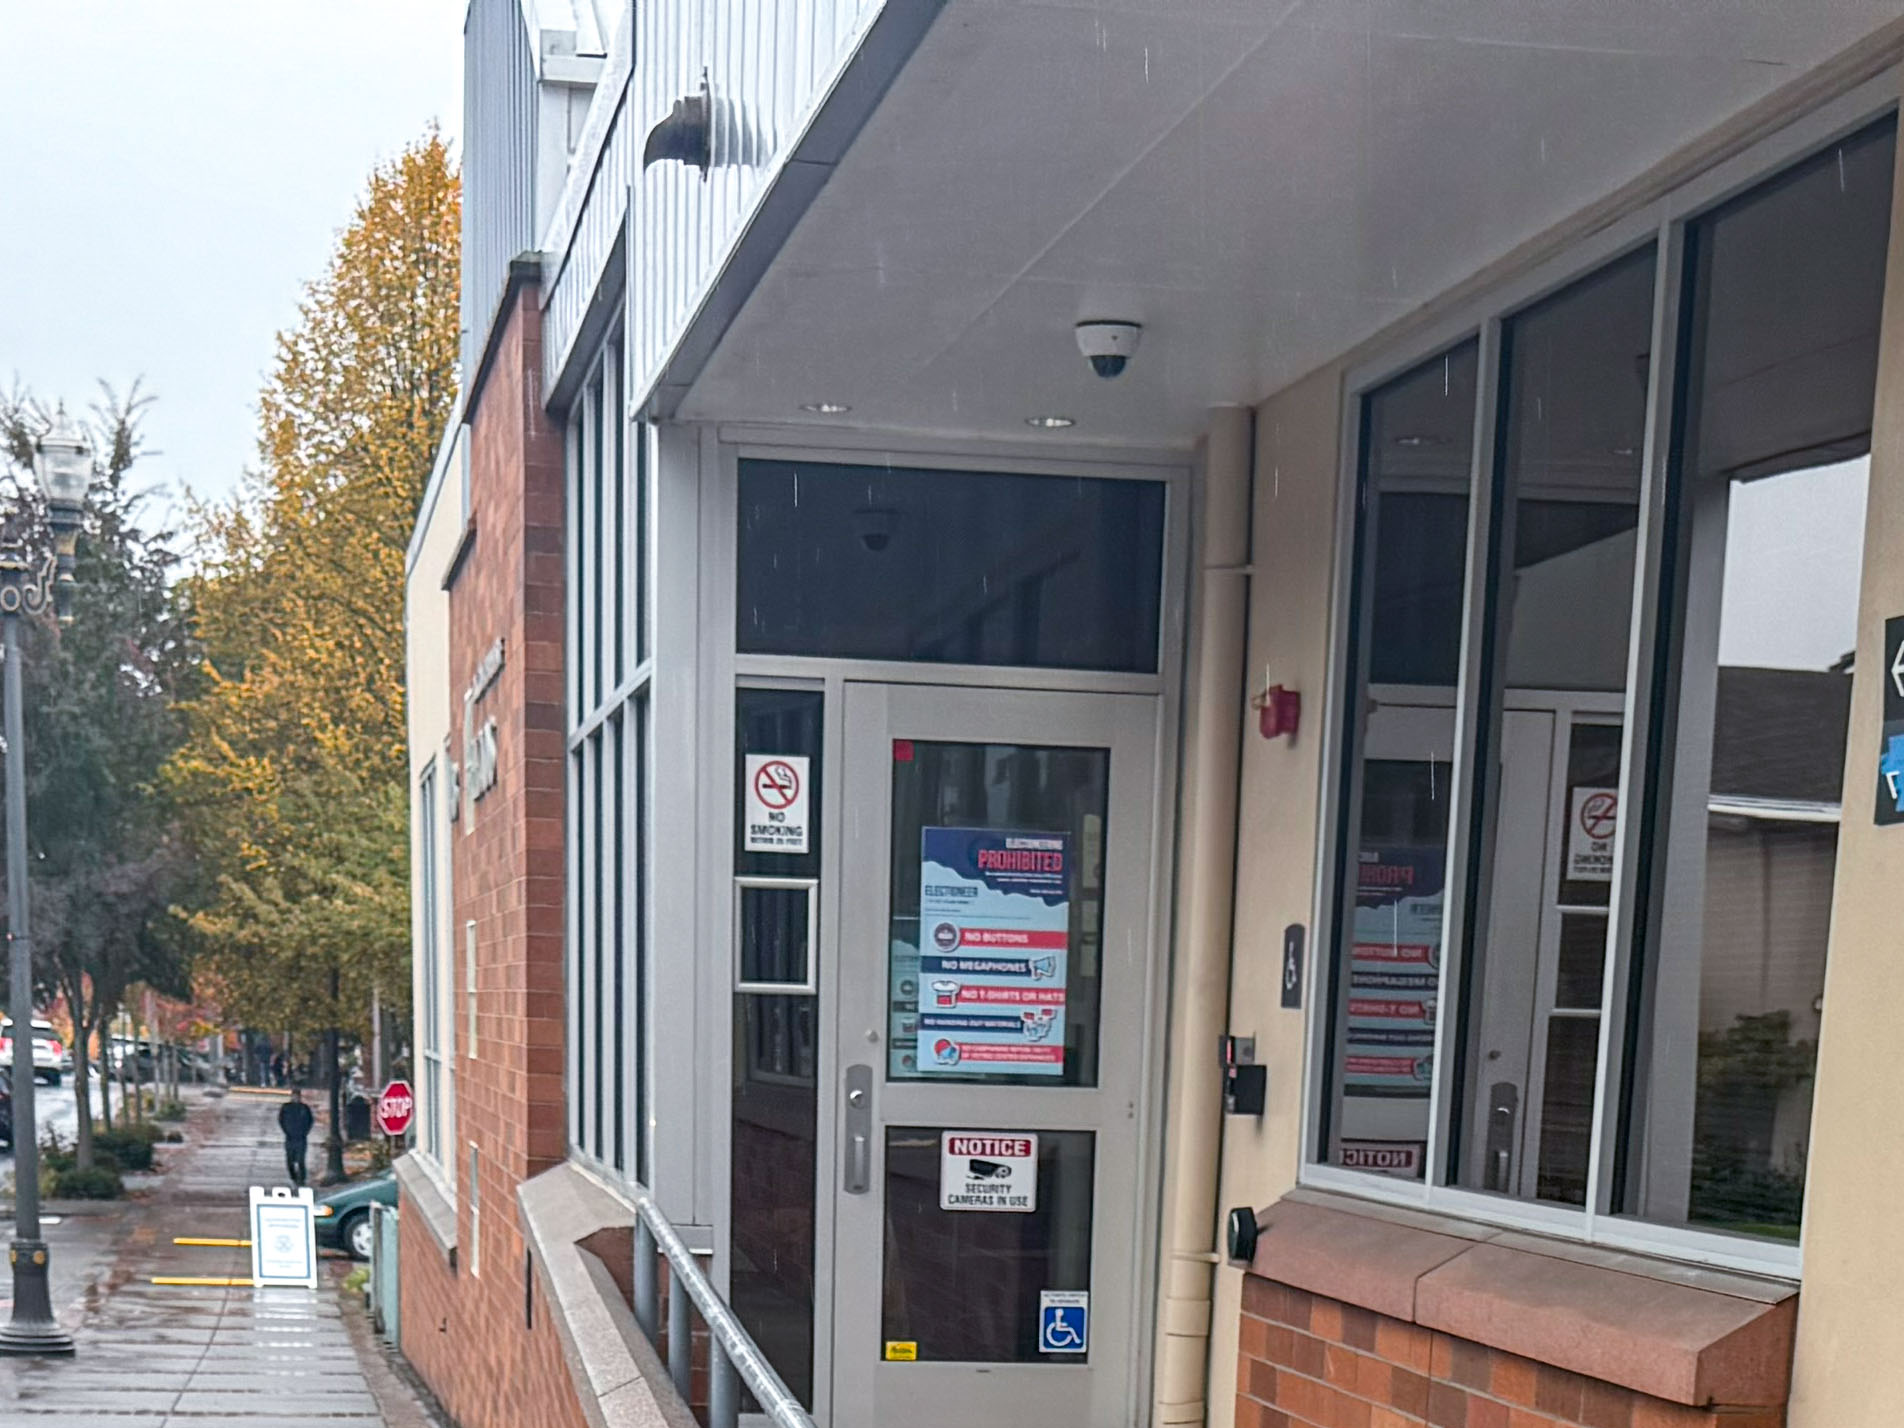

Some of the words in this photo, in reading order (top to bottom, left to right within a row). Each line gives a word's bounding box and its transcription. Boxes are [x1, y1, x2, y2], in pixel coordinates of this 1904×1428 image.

[768, 812, 786, 823] NO
[750, 824, 803, 837] SMOKING
[978, 849, 1063, 872] PROHIBITED
[380, 1097, 412, 1119] STOP
[954, 1140, 1026, 1156] NOTICE
